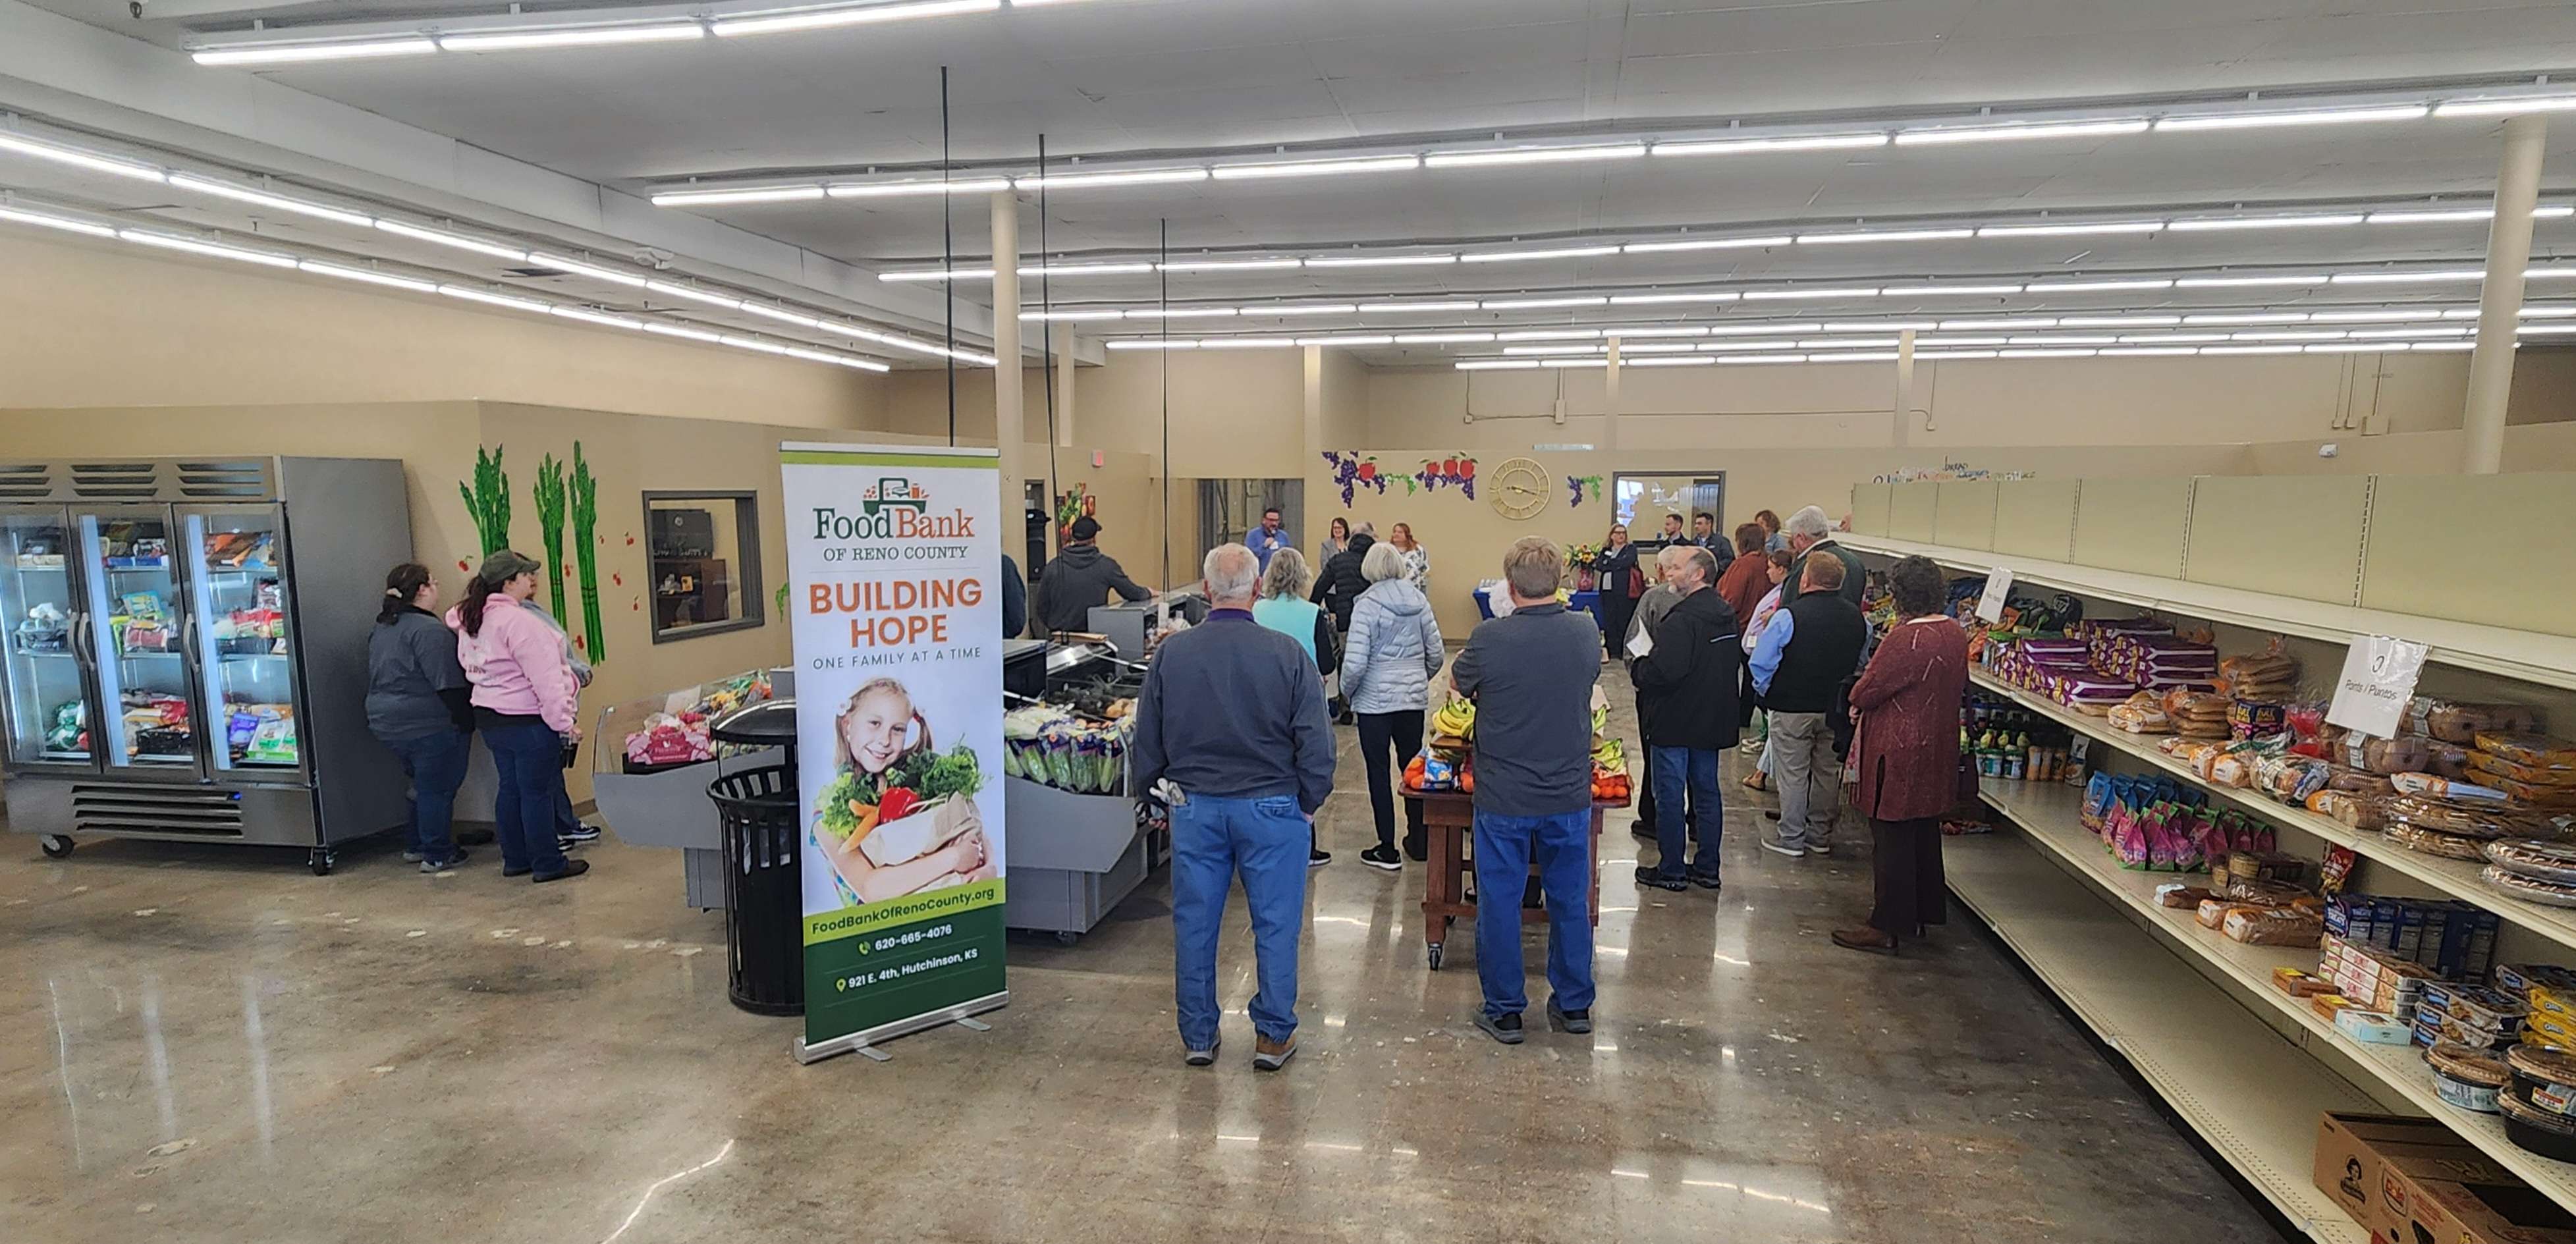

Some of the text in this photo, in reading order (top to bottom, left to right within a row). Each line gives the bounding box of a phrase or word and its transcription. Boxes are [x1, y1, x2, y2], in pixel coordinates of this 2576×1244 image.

[823, 546, 968, 561] OF RENO COUNTY
[809, 578, 981, 614] BUILDING
[851, 614, 947, 648] HOPE
[813, 647, 981, 669] ONE FAMILY AT A TIME
[812, 889, 995, 934] FoodBankOfRenoCounty.org
[875, 924, 952, 950] 620-665-4076
[848, 948, 978, 988] 921 E. 4th, Hutchinson, KS
